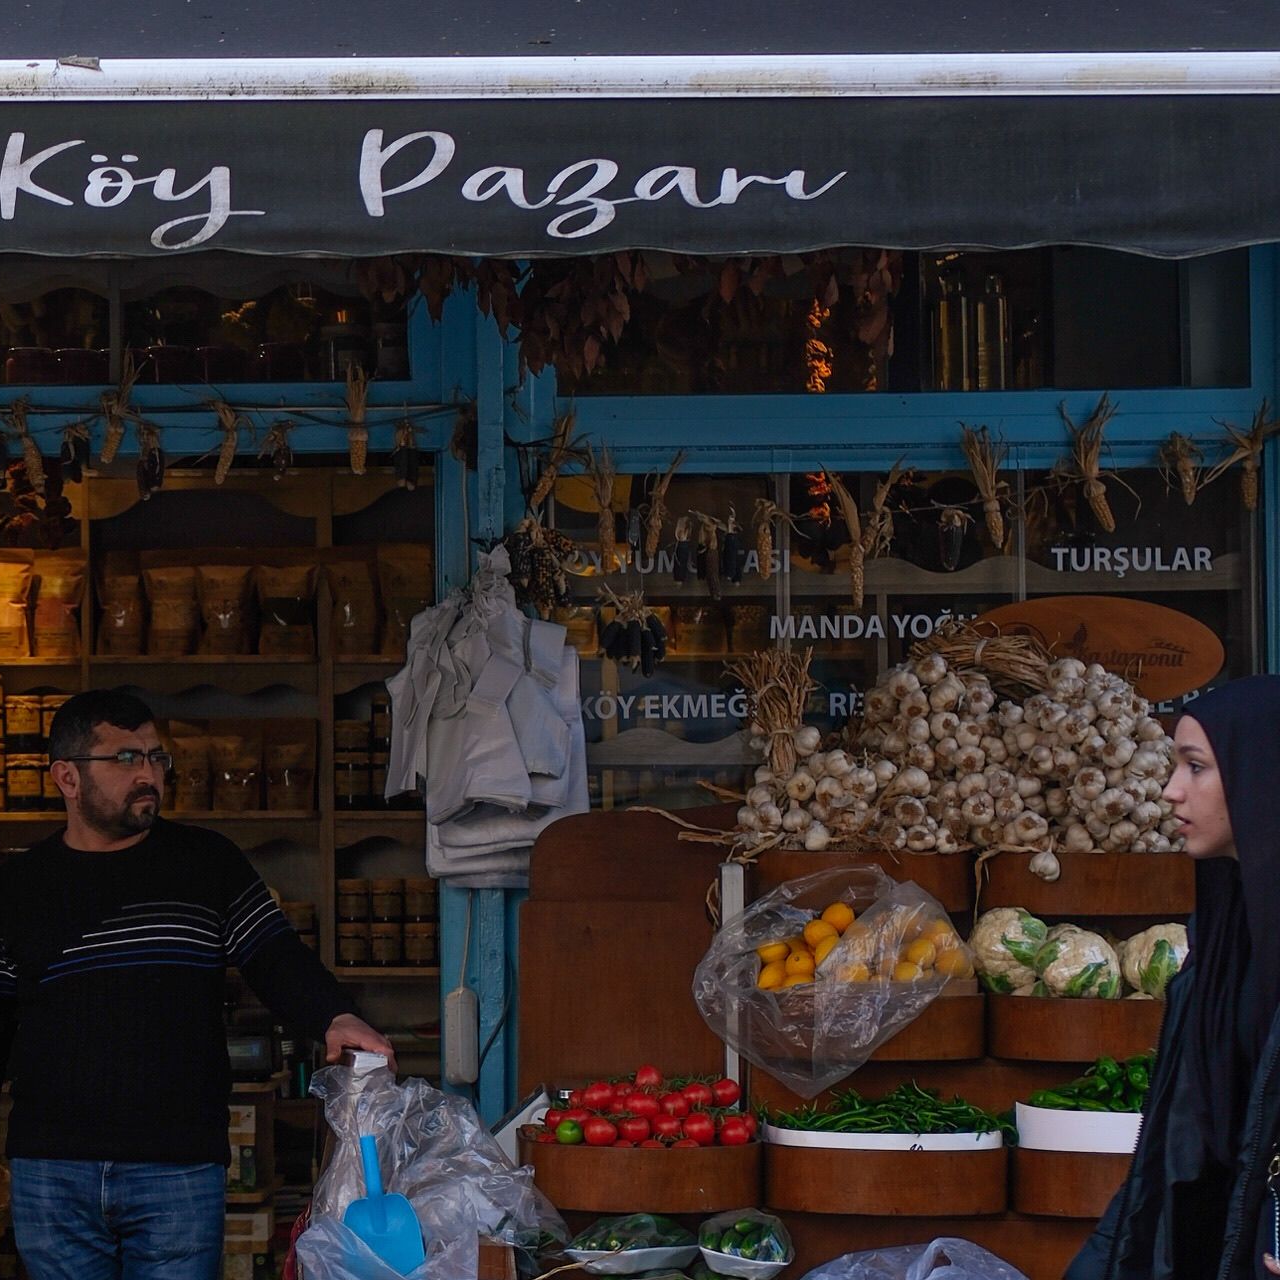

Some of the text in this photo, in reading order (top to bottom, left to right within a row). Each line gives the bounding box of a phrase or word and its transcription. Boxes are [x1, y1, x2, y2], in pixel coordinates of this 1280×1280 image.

[358, 128, 849, 239] Pazarı
[1050, 546, 1213, 579] TURŞULAR
[770, 615, 886, 640] MANDA
